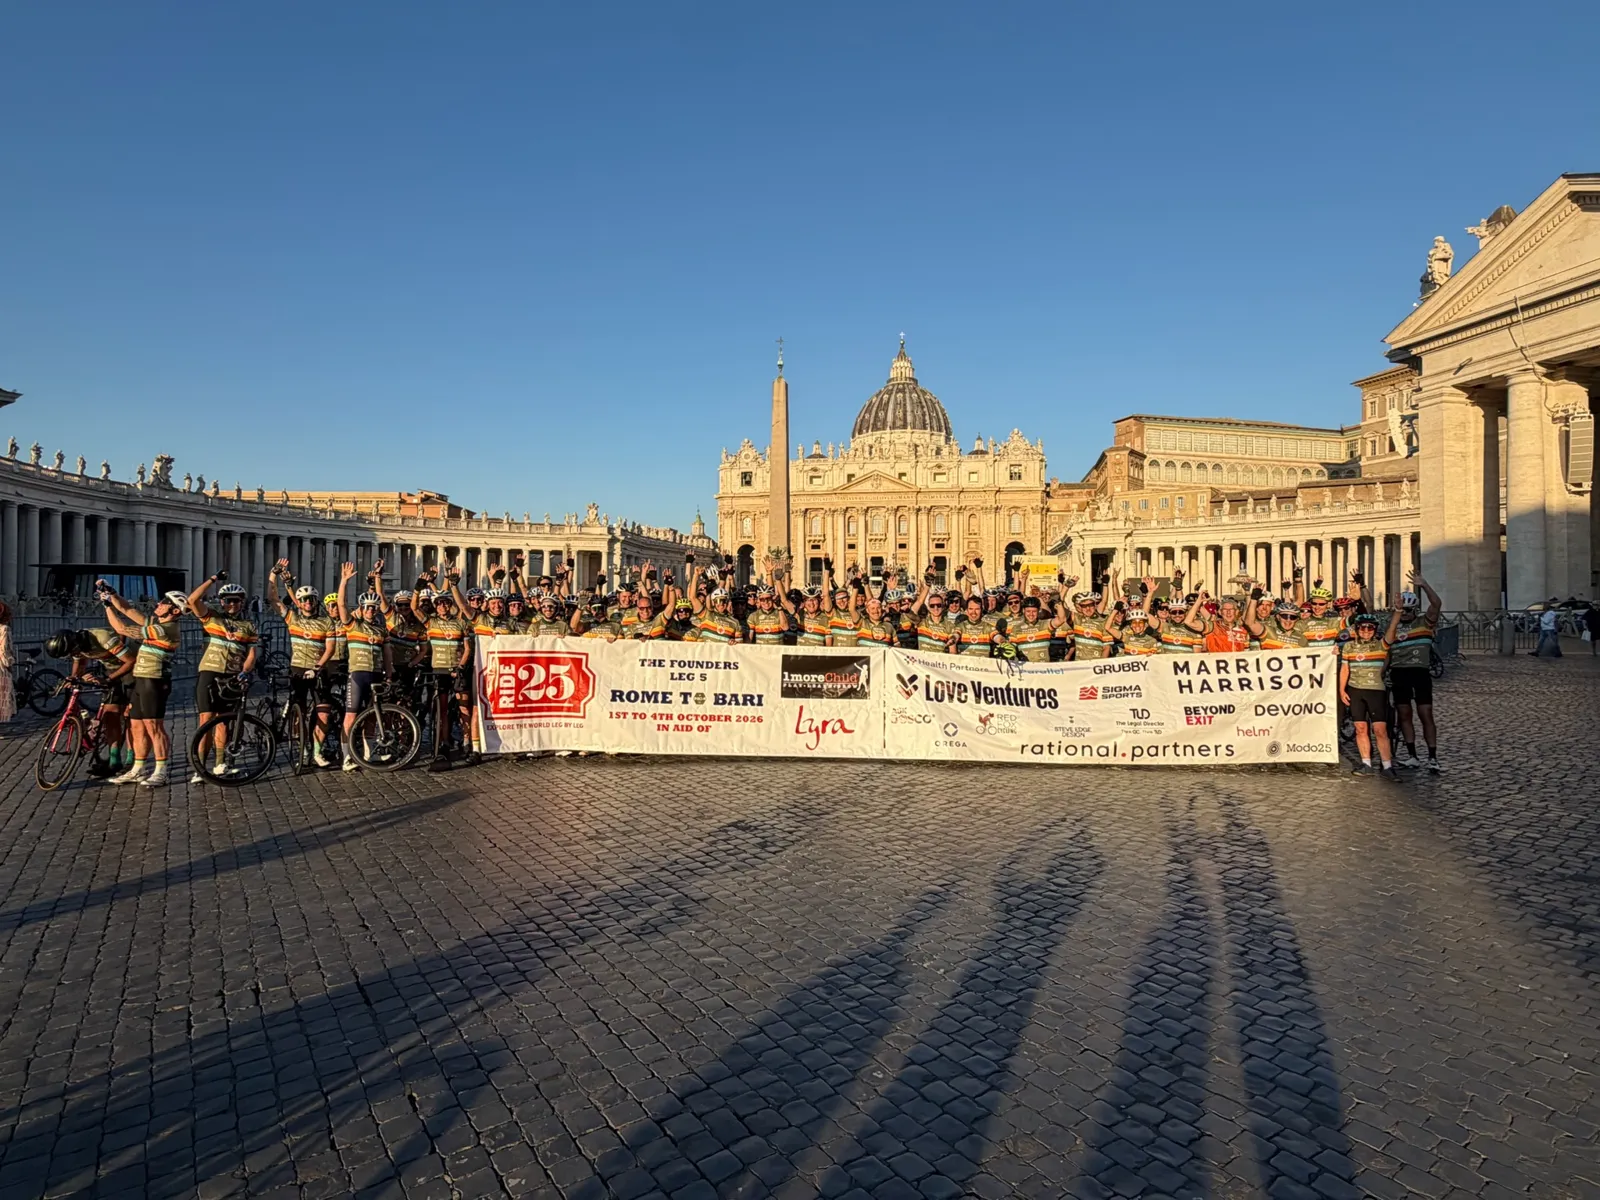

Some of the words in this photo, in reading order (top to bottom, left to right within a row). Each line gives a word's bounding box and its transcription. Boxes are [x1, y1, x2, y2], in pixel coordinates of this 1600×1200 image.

[639, 658, 666, 668] THE
[669, 659, 740, 670] FOUNDERS
[918, 658, 948, 670] Health
[1173, 654, 1321, 676] MARRIOTT
[517, 663, 575, 701] 25
[669, 672, 695, 681] LEG
[699, 673, 707, 682] 5
[783, 671, 858, 683] 1moreChild
[499, 663, 516, 708] RIDE
[1102, 684, 1142, 693] SIGMA
[1177, 673, 1324, 694] HARRISON
[925, 674, 968, 704] Love
[970, 680, 1059, 709] Ventures
[1102, 691, 1142, 700] SPORTS
[610, 689, 673, 704] ROME
[713, 692, 764, 707] BARI
[1184, 704, 1236, 716] BEYOND
[608, 711, 629, 720] 1ST
[631, 712, 646, 720] TO
[650, 712, 674, 721] 4TH
[677, 713, 732, 723] OCTOBER
[735, 714, 764, 723] 2026
[997, 713, 1017, 721] RED
[1186, 715, 1215, 726] EXIT
[487, 723, 515, 731] EXPLORE
[516, 722, 527, 730] THE
[528, 721, 551, 729] WORLD
[656, 723, 669, 732] IN
[673, 724, 693, 732] AID
[697, 724, 712, 733] OF
[795, 705, 855, 751] Lyra
[1286, 743, 1332, 753] Modo25
